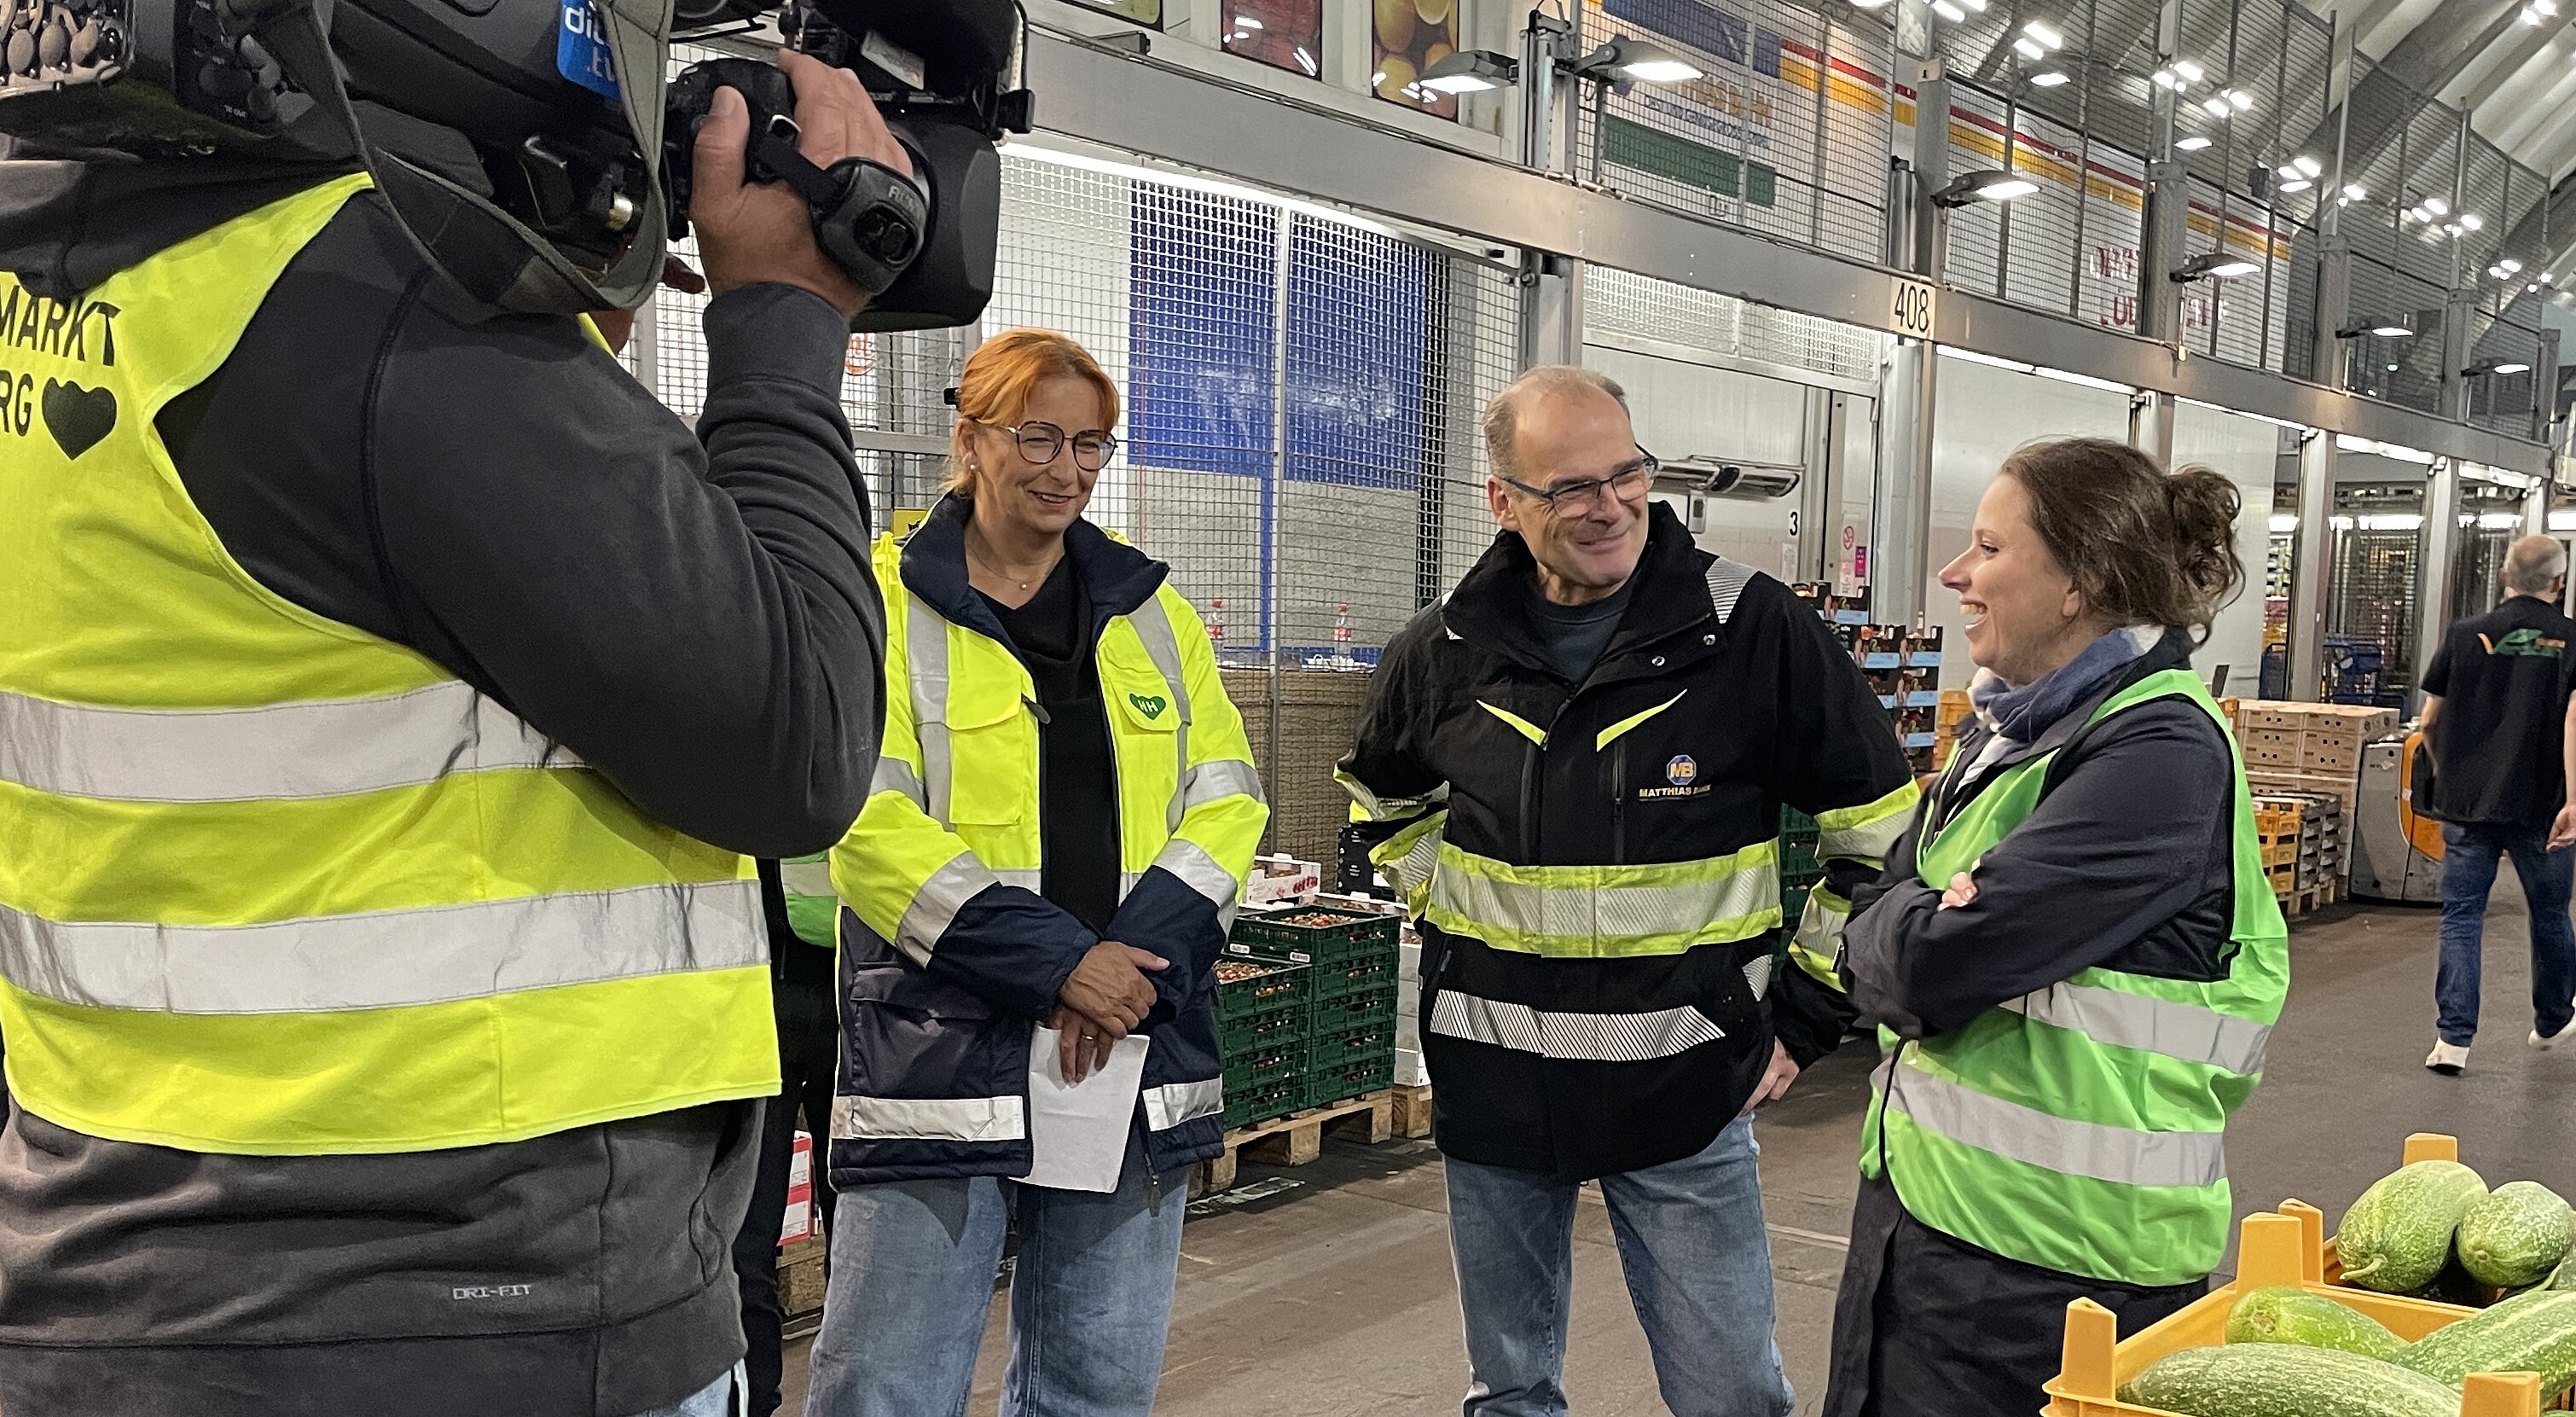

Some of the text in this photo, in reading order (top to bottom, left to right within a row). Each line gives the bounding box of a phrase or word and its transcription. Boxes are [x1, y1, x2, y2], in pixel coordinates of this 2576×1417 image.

[1894, 282, 1929, 333] 408
[1790, 511, 1798, 536] 3
[1137, 700, 1159, 713] HH
[1669, 762, 1694, 778] MB
[1639, 787, 1692, 798] MATTHIAS
[452, 1284, 531, 1301] DRI-FIT
